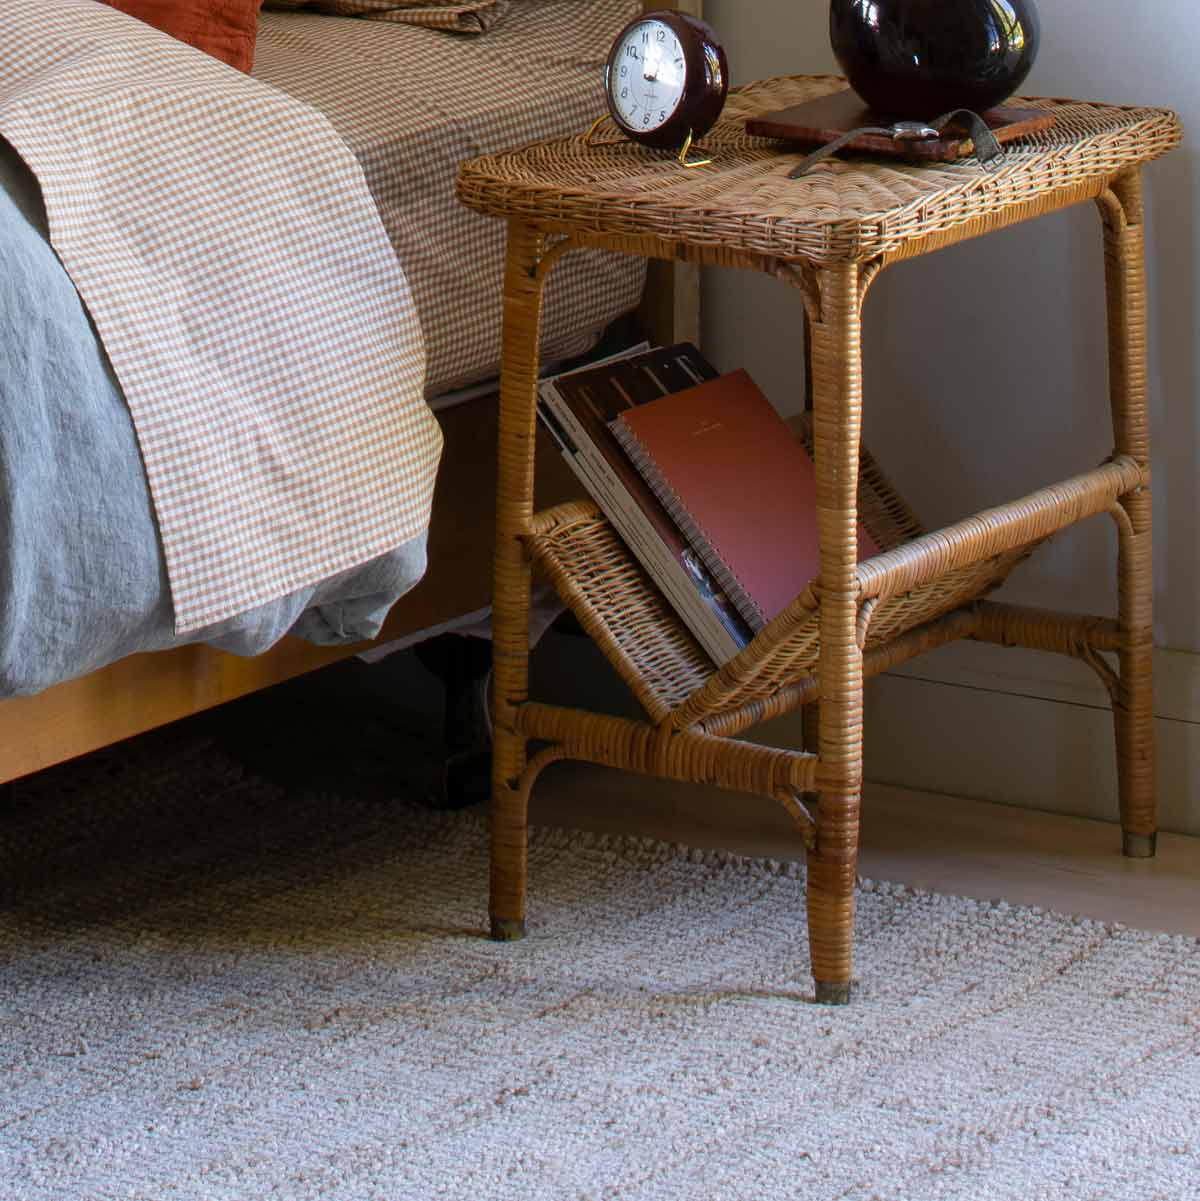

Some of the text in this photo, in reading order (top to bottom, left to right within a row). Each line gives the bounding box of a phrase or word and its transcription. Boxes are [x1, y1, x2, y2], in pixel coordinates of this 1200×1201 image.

[641, 31, 649, 44] 11
[656, 30, 665, 43] 12
[625, 45, 637, 57] 10
[620, 65, 628, 78] 9
[620, 87, 628, 98] 8
[629, 104, 638, 116] 7
[658, 110, 666, 122] 5
[643, 113, 650, 124] 6
